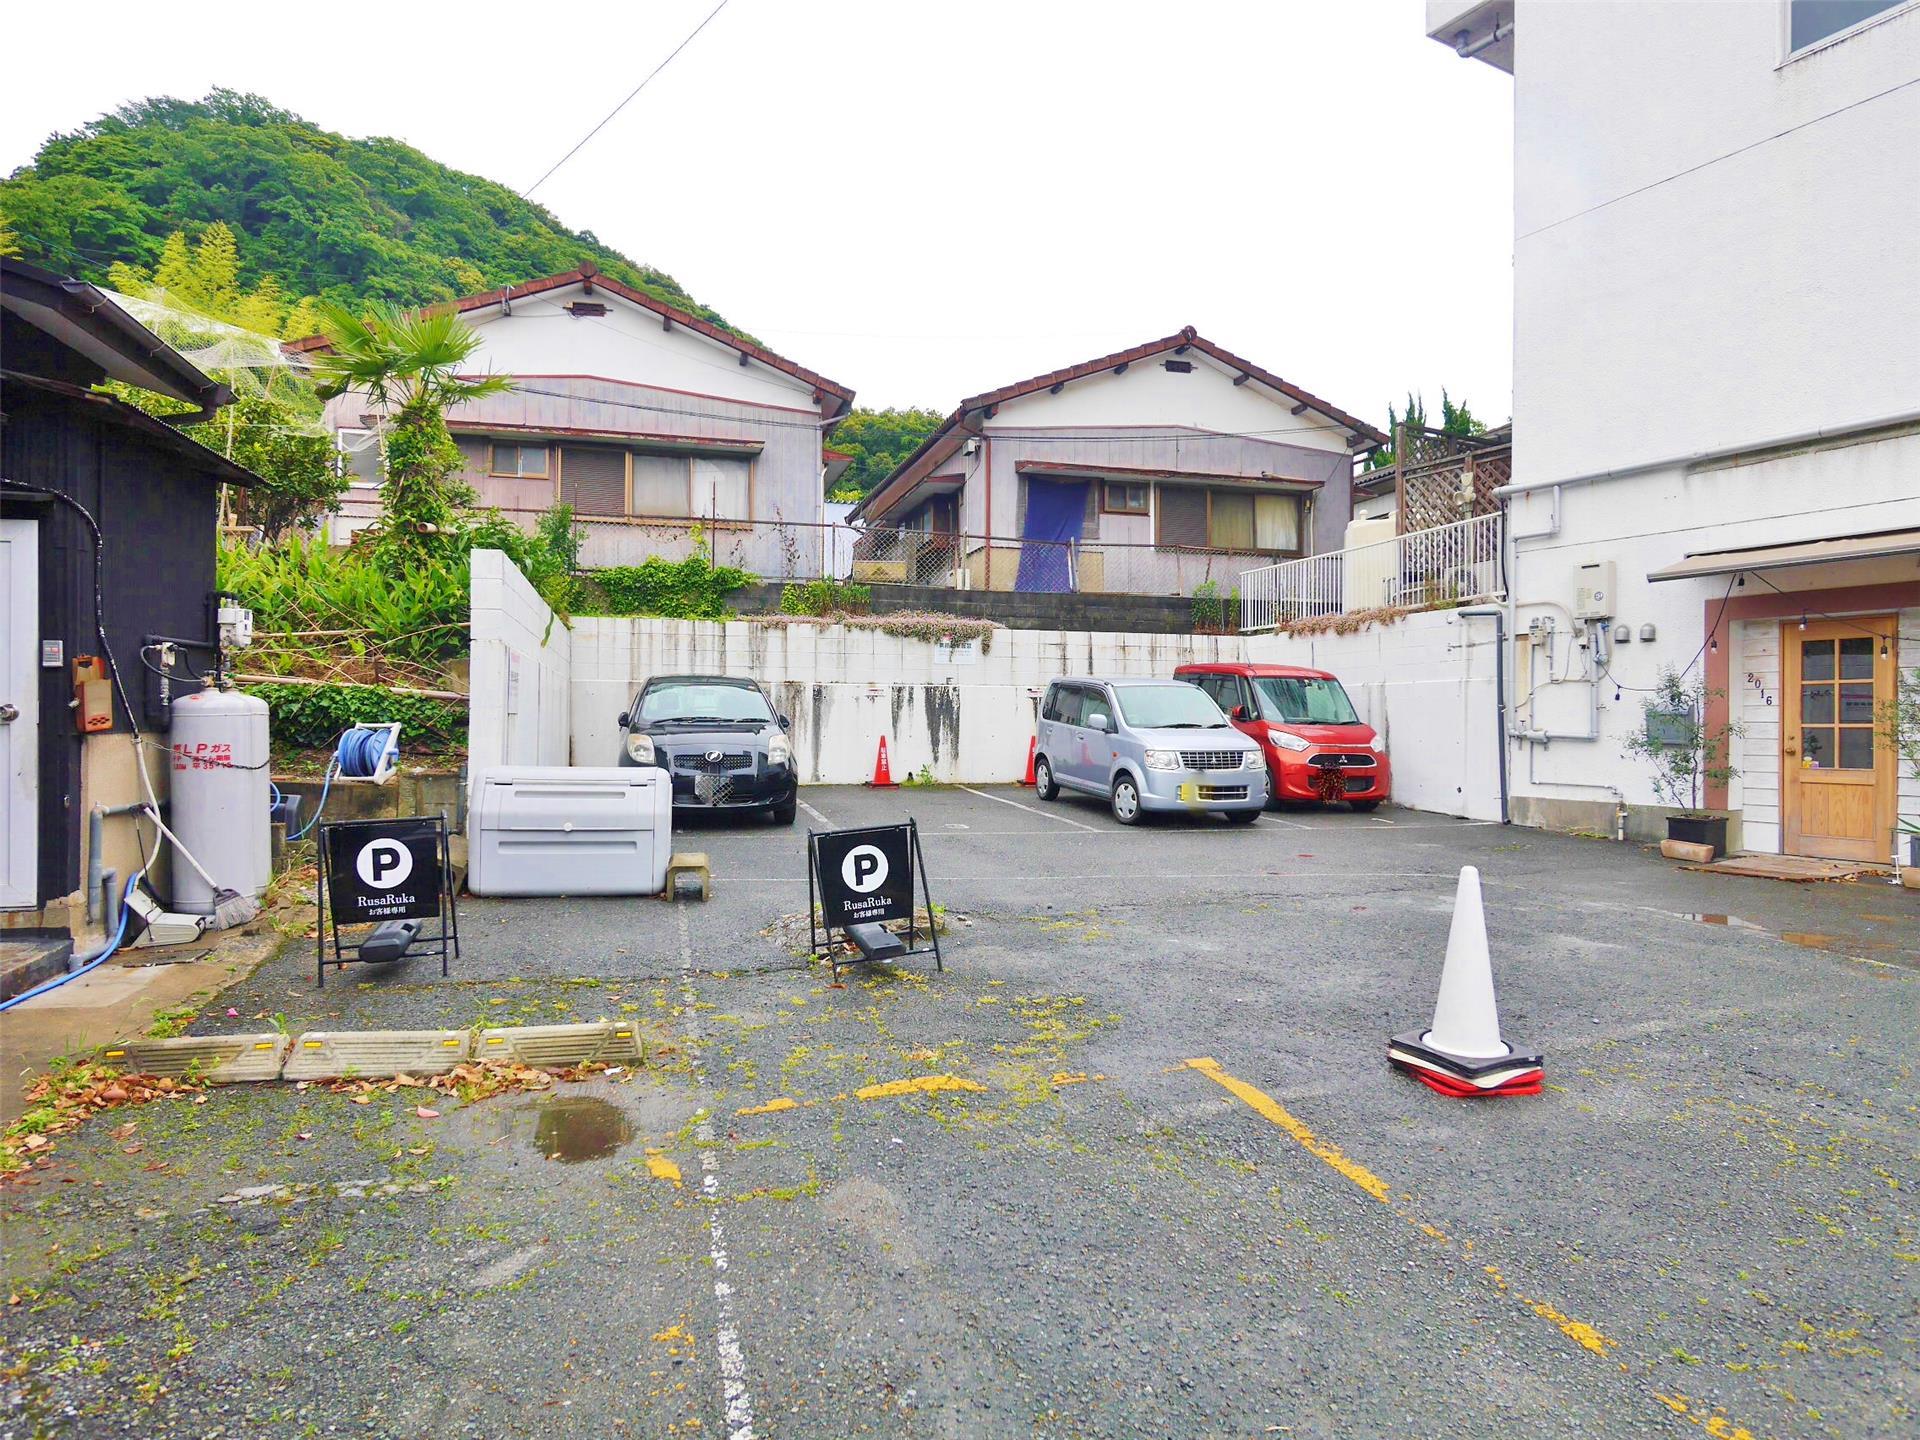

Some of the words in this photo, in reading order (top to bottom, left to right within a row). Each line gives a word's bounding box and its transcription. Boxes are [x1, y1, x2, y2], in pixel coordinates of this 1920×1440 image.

[1747, 672, 1773, 706] 2016
[371, 847, 401, 882] P
[853, 853, 879, 887] P
[357, 893, 416, 907] RusaRuka
[368, 906, 406, 916] お客様専用
[843, 895, 892, 911] RusaRuka
